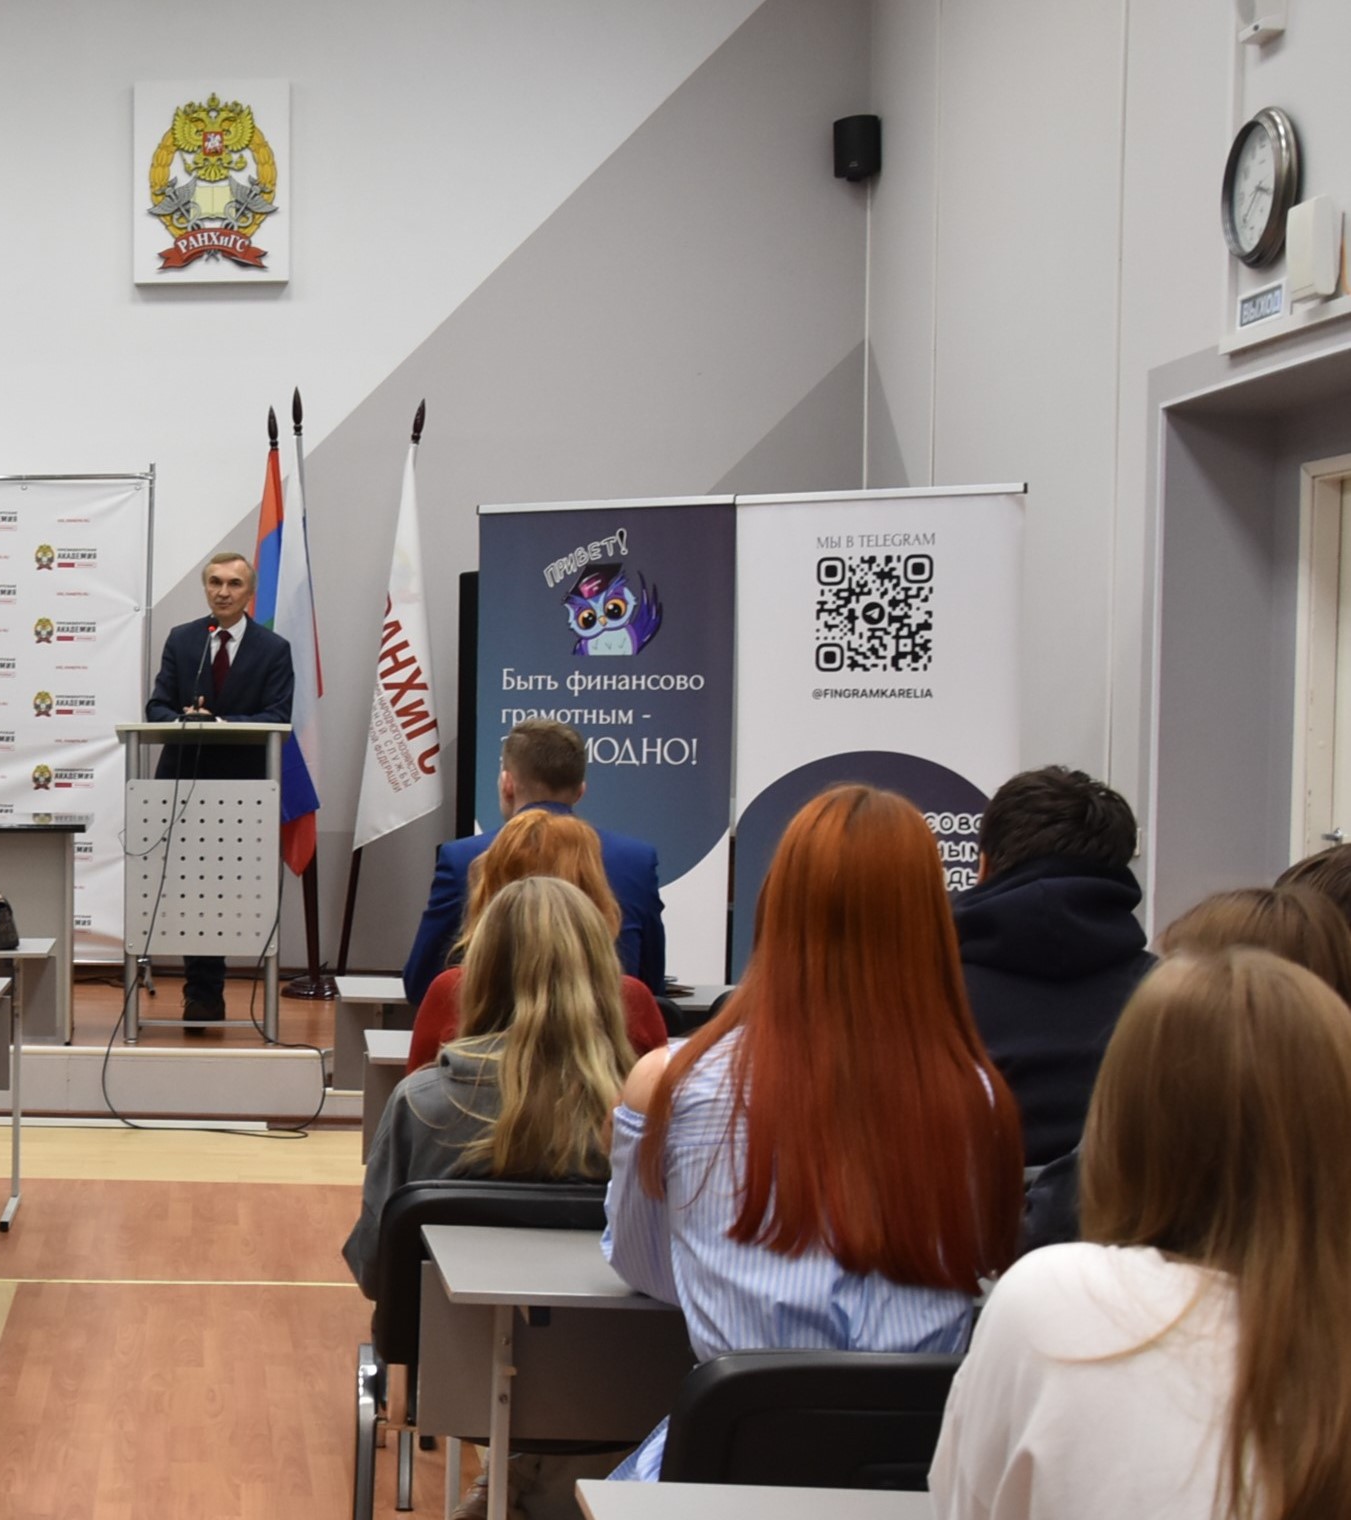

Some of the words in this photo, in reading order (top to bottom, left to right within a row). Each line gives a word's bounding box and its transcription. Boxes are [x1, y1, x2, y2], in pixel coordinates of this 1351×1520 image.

[177, 231, 249, 253] РАНХиГС
[816, 535, 841, 549] МЫ
[846, 535, 854, 548] В
[858, 532, 936, 548] TELEGRAM
[543, 528, 628, 588] ПРИВЕТ!
[502, 668, 558, 690] Быть
[566, 670, 705, 697] финансово
[811, 688, 933, 700] @FINGRAMKARELIA
[501, 708, 633, 726] грамотным
